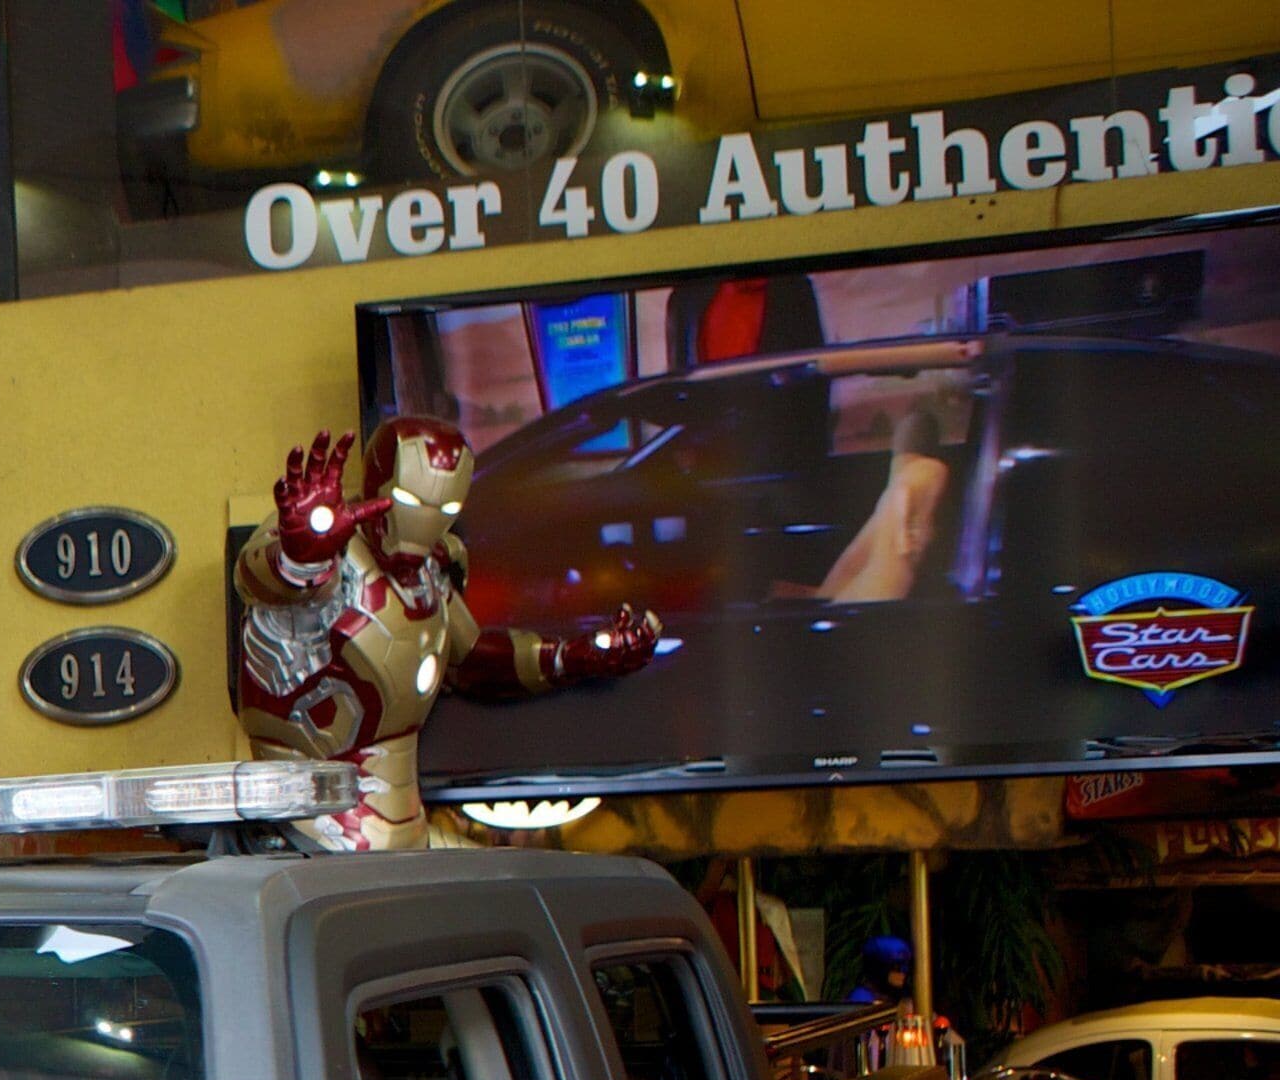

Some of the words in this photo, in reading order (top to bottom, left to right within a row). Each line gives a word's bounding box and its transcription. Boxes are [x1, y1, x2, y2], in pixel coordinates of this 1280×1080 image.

[245, 181, 503, 270] Over
[540, 151, 660, 238] 40
[56, 527, 132, 579] 910
[1088, 575, 1232, 613] HOLLYWOOD
[1092, 621, 1234, 649] Star
[60, 650, 136, 701] 914
[1095, 646, 1231, 672] Cars
[814, 756, 859, 767] SHARP
